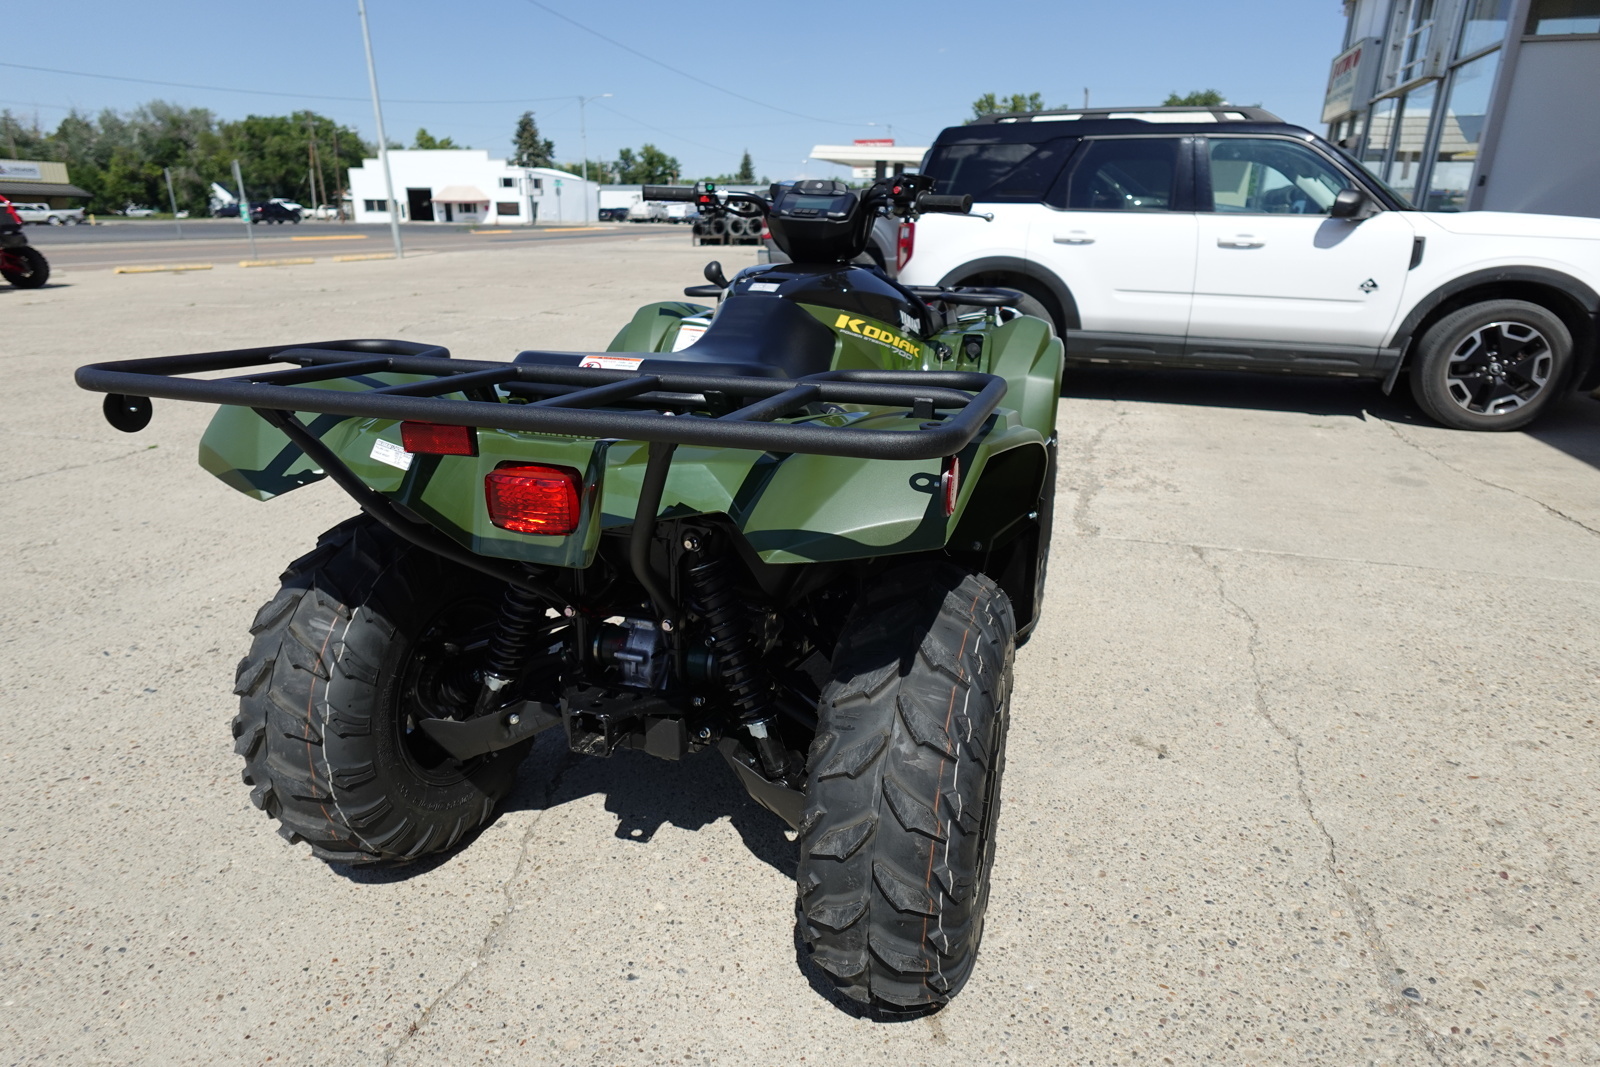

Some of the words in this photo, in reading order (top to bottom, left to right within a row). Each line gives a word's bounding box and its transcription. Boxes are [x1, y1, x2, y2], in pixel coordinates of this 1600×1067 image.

[835, 314, 920, 358] KODIAK
[840, 329, 863, 339] POWER
[891, 346, 913, 361] 700
